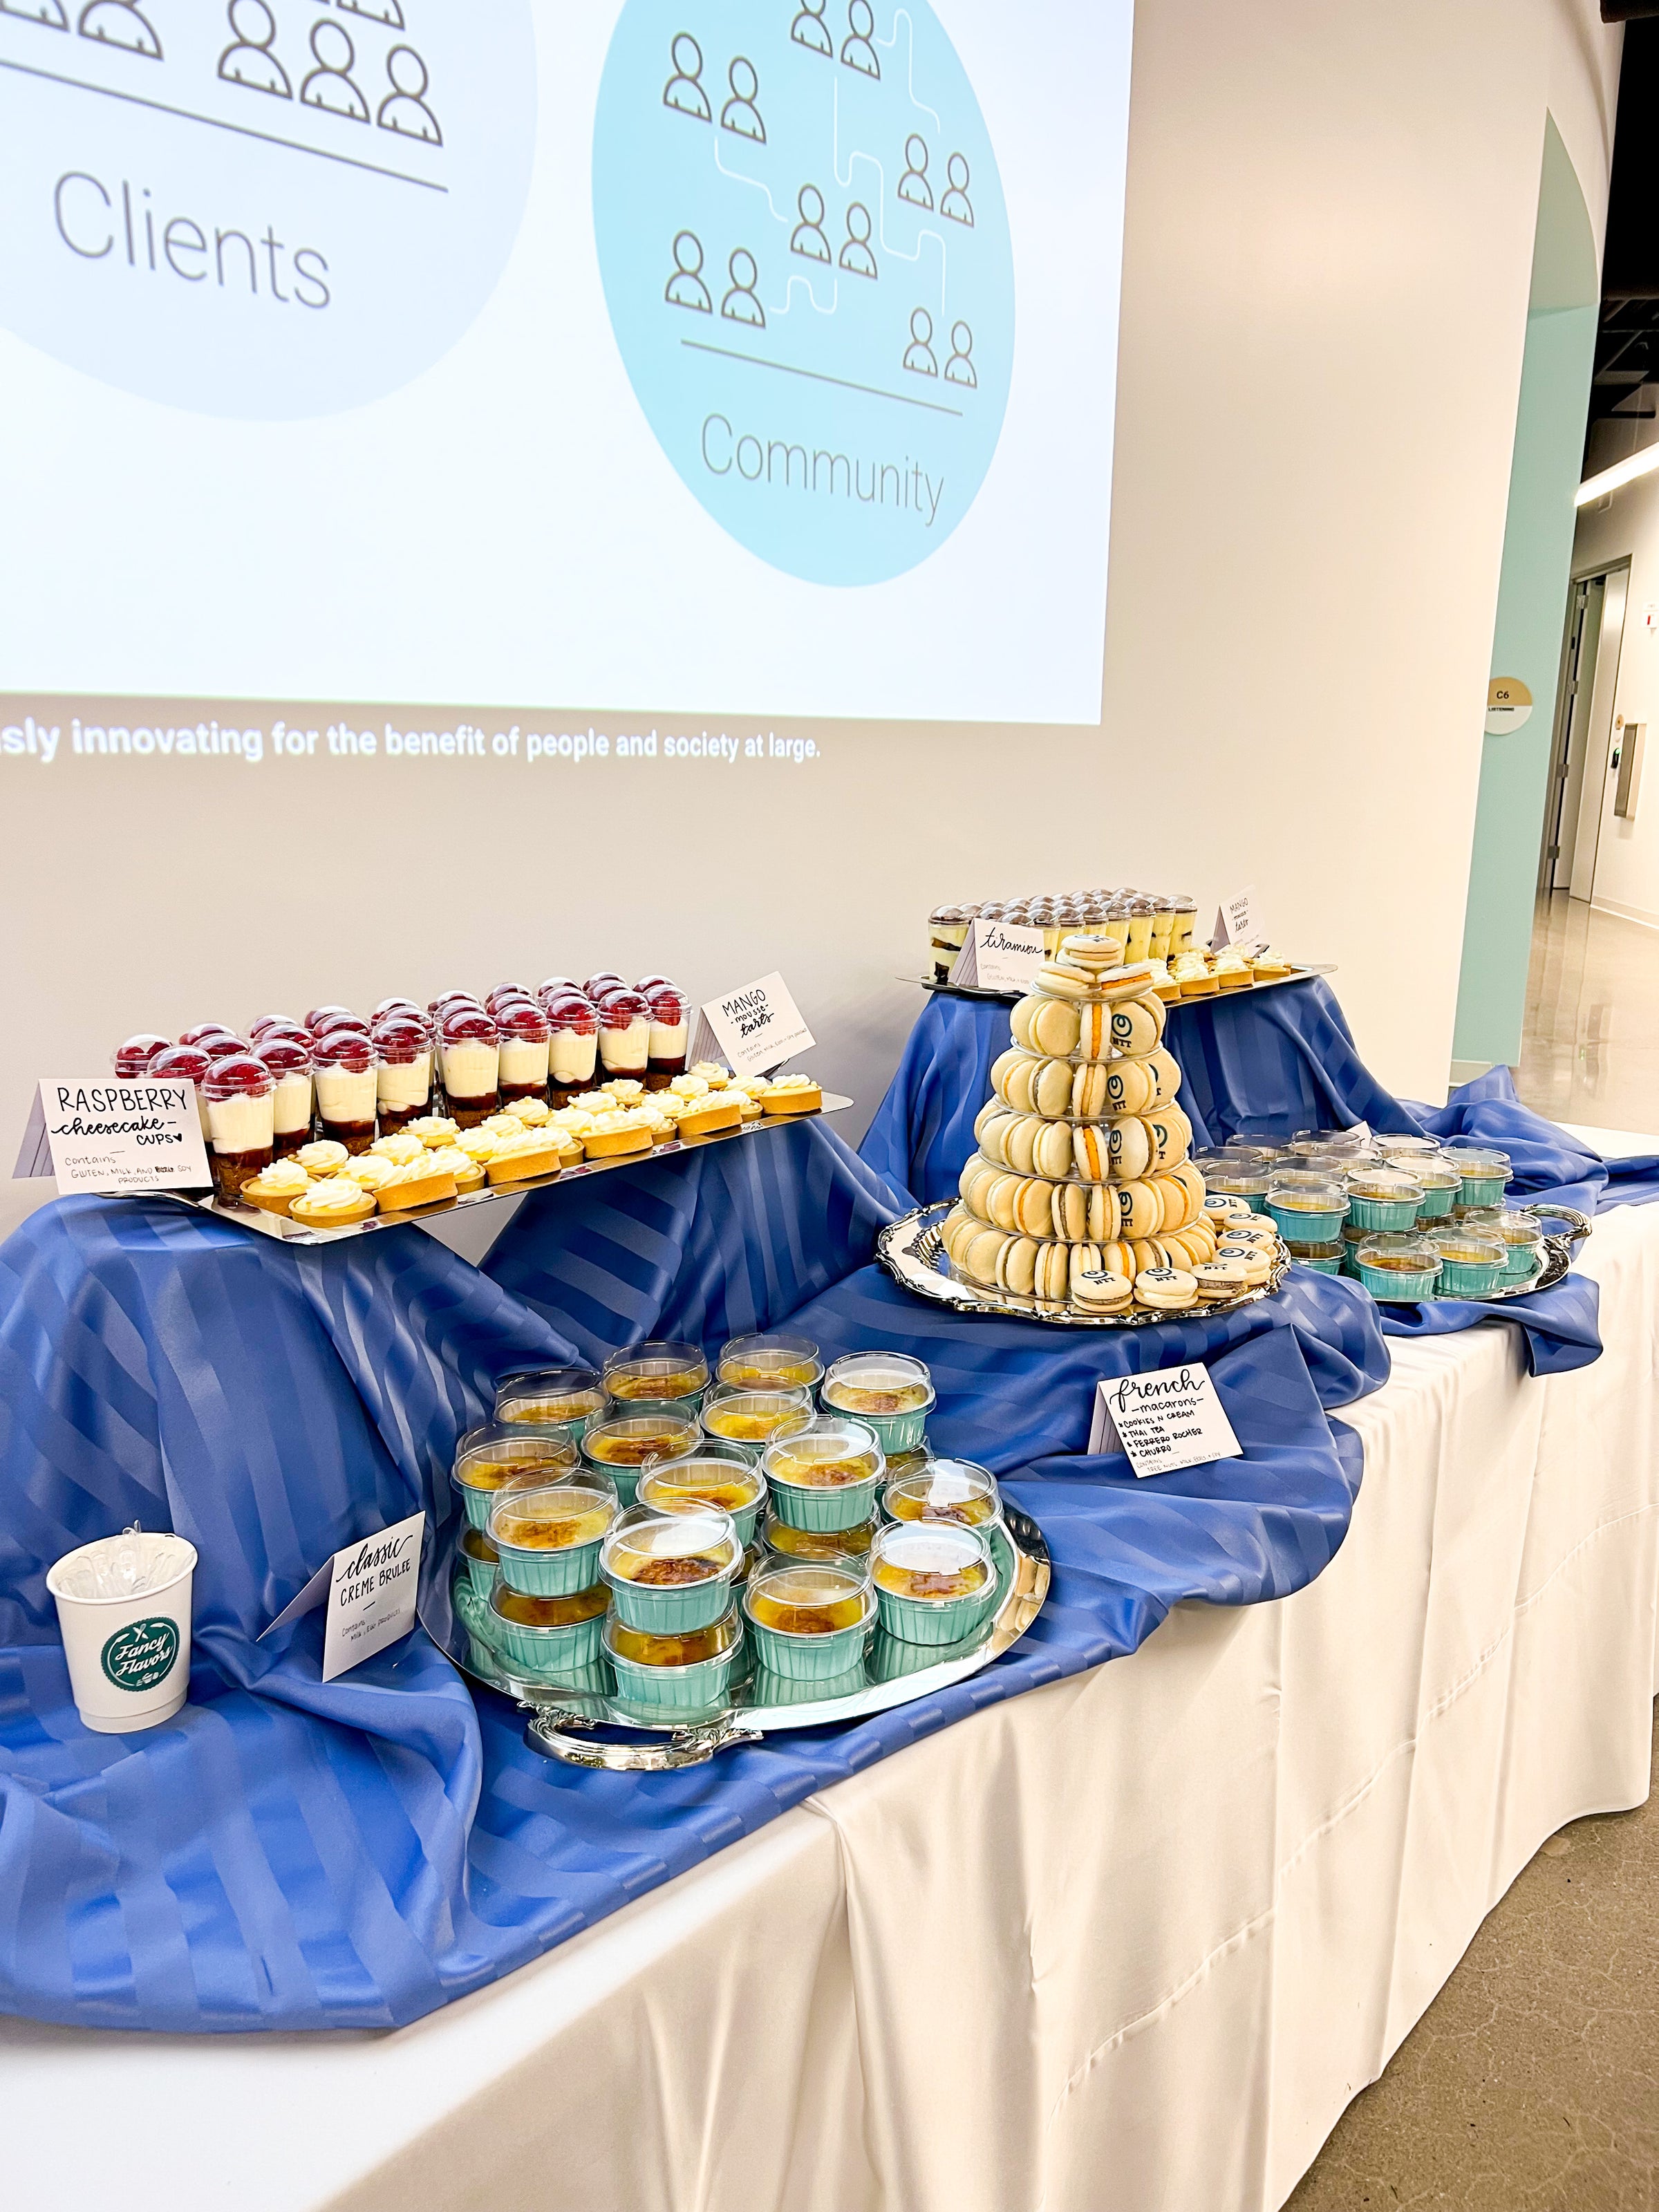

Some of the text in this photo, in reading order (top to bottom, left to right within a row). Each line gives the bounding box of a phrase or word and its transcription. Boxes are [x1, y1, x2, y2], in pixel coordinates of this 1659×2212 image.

[54, 170, 330, 309] Clients
[702, 413, 944, 527] Community
[1497, 691, 1510, 699] C6
[72, 718, 263, 762] innovating
[272, 720, 319, 755] for
[326, 722, 377, 755] the
[385, 723, 485, 756] benefit
[492, 726, 520, 756] of
[526, 727, 609, 762] people
[617, 729, 657, 757] and
[664, 731, 739, 762] society
[744, 734, 764, 758] at
[769, 731, 821, 762] large.
[980, 927, 1042, 954] tiramisu
[722, 989, 766, 1017] MANGO
[1112, 1037, 1132, 1048] NTT
[57, 1087, 187, 1112] RASPBERRY
[136, 1134, 174, 1145] CUPS
[1109, 1369, 1205, 1413] french
[1123, 1418, 1154, 1428] COOKIES
[1167, 1409, 1194, 1419] CREAM
[1128, 1429, 1147, 1438] THAI
[1134, 1427, 1203, 1447] FERRERO ROCHER
[1139, 1445, 1171, 1457] CHURRO
[336, 1535, 413, 1582] classic
[341, 1558, 411, 1606] CREME BRULEE
[342, 1620, 366, 1637] Contains
[115, 1632, 170, 1660] Fancy
[115, 1646, 174, 1676] Flavors
